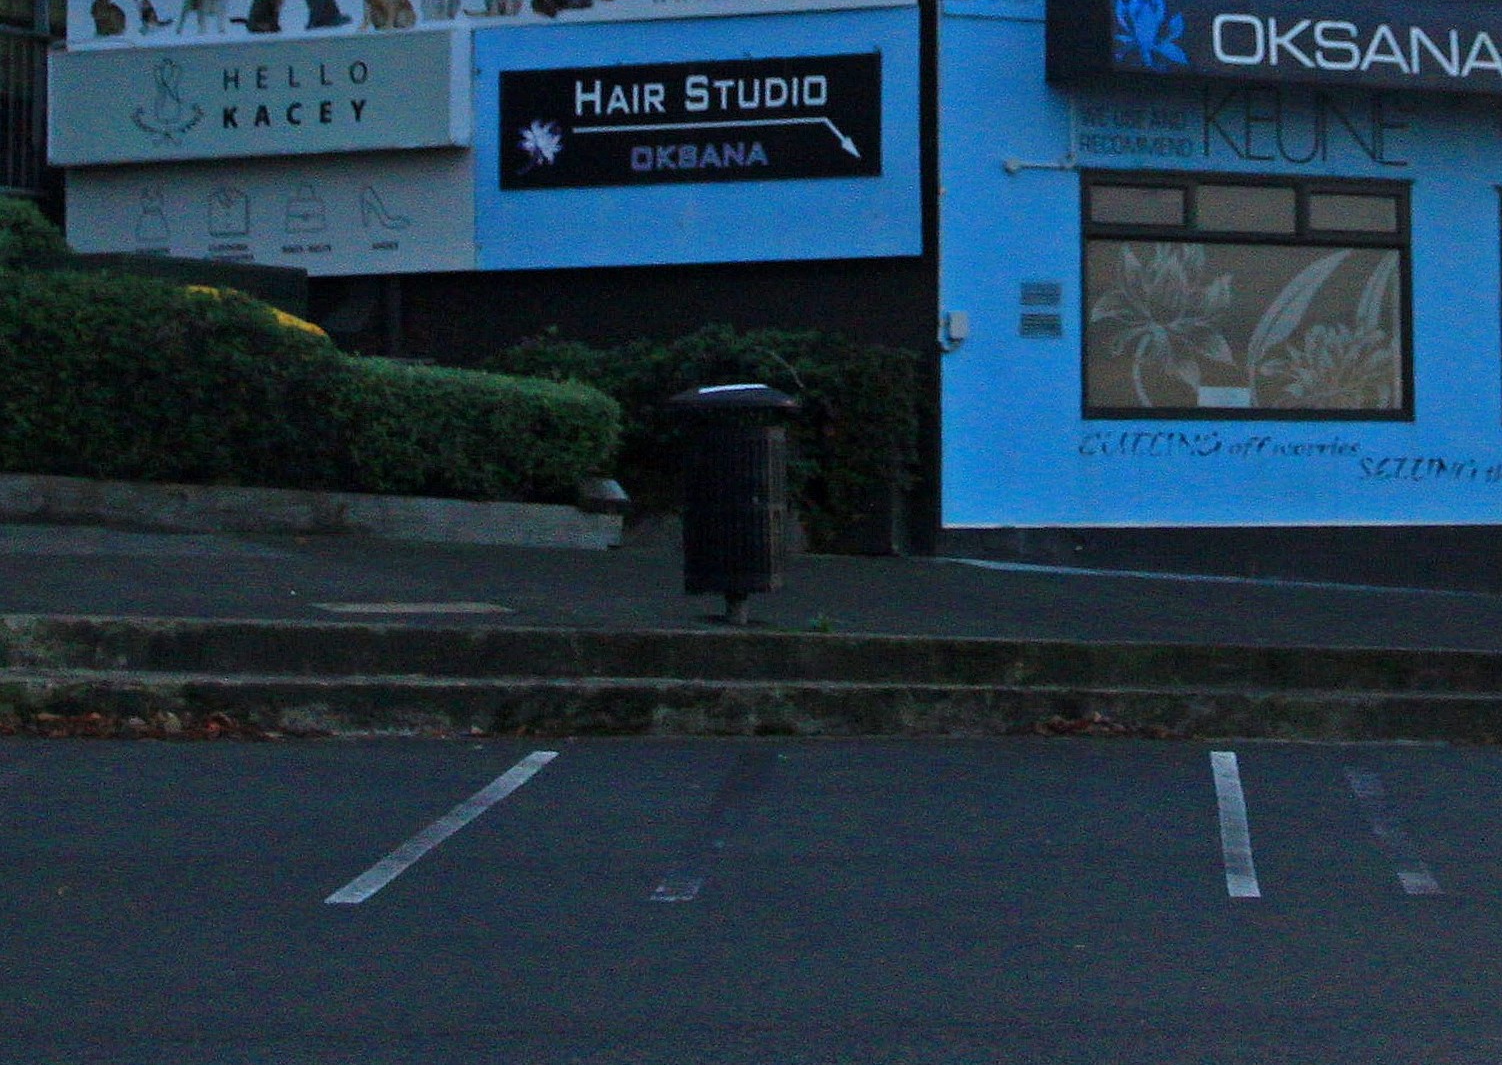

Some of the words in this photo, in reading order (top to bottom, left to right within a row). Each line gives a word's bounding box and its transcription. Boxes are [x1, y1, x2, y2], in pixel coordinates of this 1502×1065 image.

[223, 60, 369, 91] HELLO
[574, 79, 666, 116] HAIR
[684, 74, 828, 112] STUDIO
[223, 99, 369, 129] KACEY
[1203, 84, 1409, 166] KEUNE
